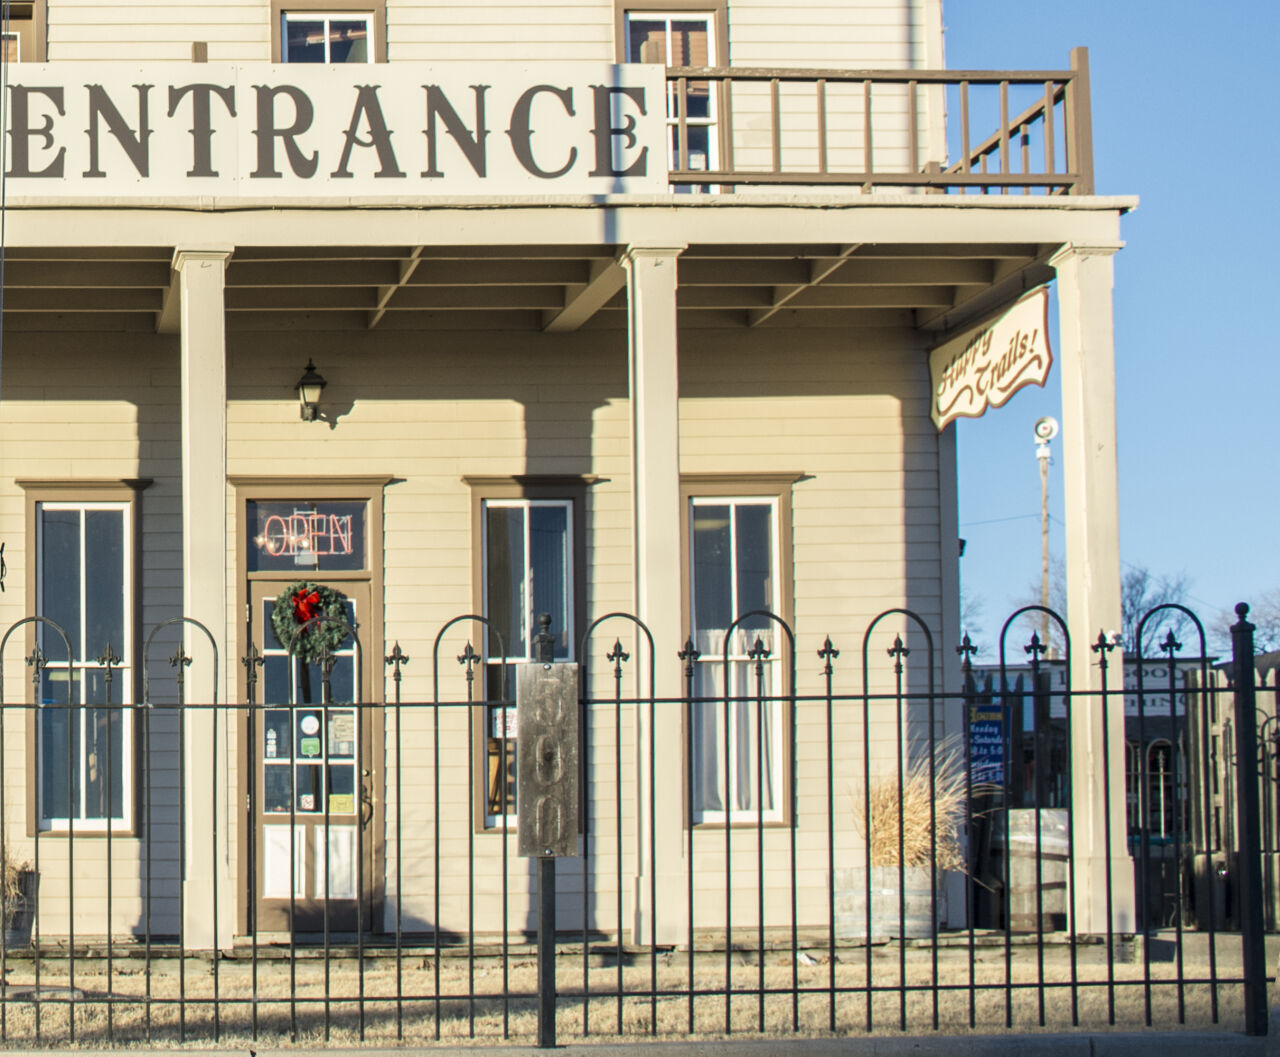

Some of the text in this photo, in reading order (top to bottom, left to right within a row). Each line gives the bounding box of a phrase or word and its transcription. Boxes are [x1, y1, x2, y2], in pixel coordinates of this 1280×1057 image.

[5, 83, 648, 180] ENTRANCE
[937, 329, 993, 397] Happy
[975, 329, 1038, 396] Trails!
[265, 514, 352, 556] OPEN
